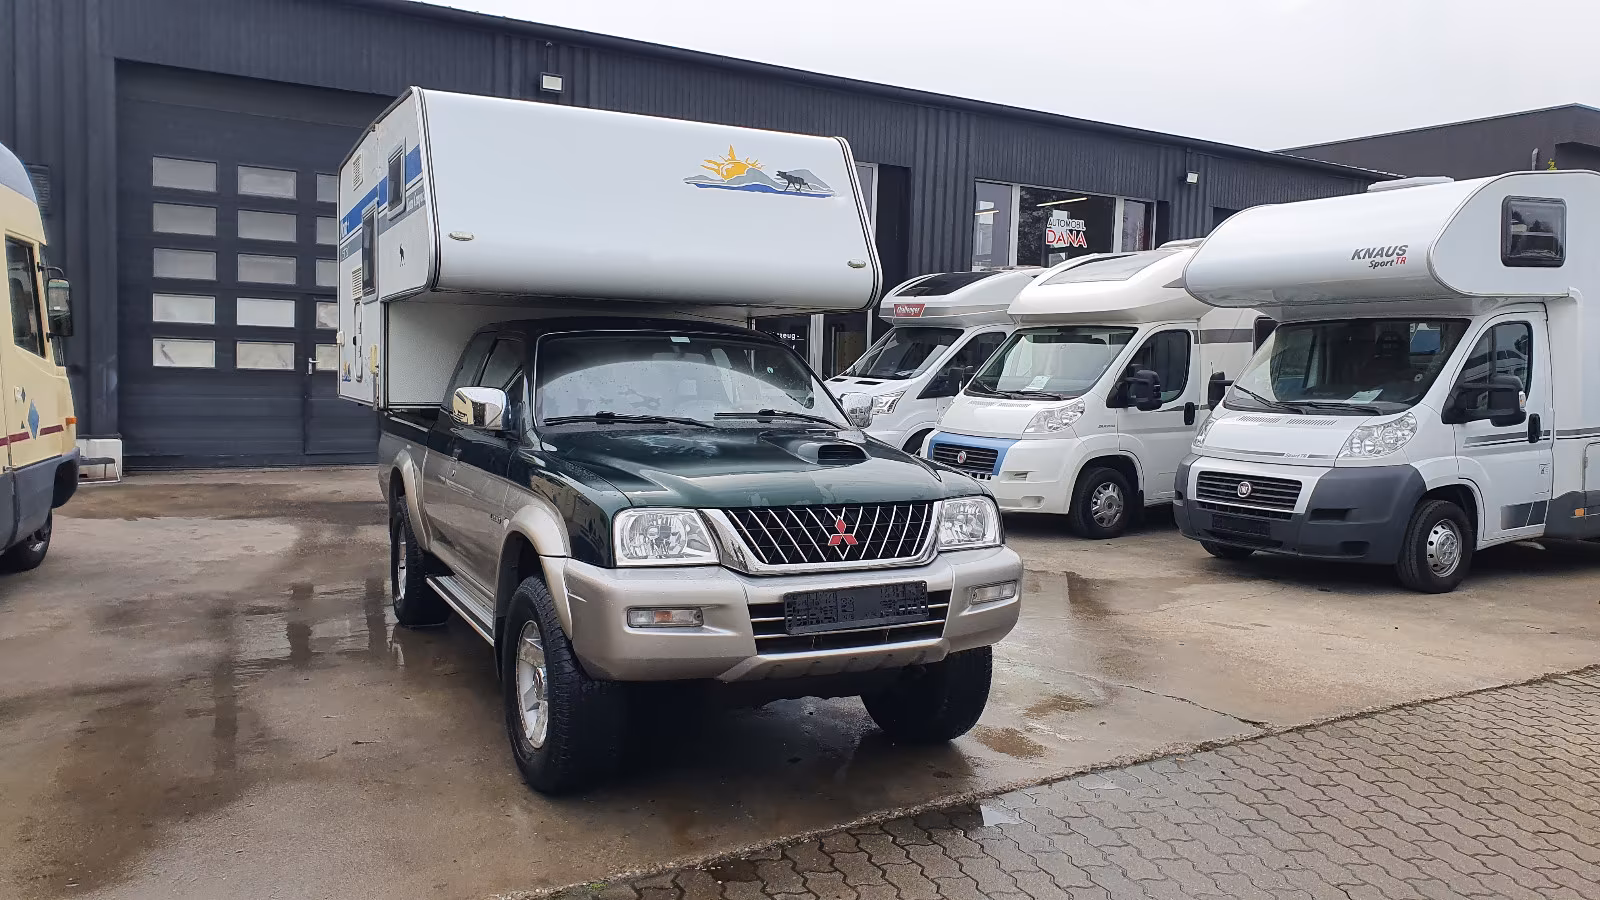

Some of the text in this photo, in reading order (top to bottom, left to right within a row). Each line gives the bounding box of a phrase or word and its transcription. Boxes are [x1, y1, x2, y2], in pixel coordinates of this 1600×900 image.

[1047, 217, 1086, 230] AUTOMOBIL
[1046, 229, 1087, 248] DANA
[1351, 244, 1409, 261] KNAUS
[1368, 256, 1407, 270] Sport TR
